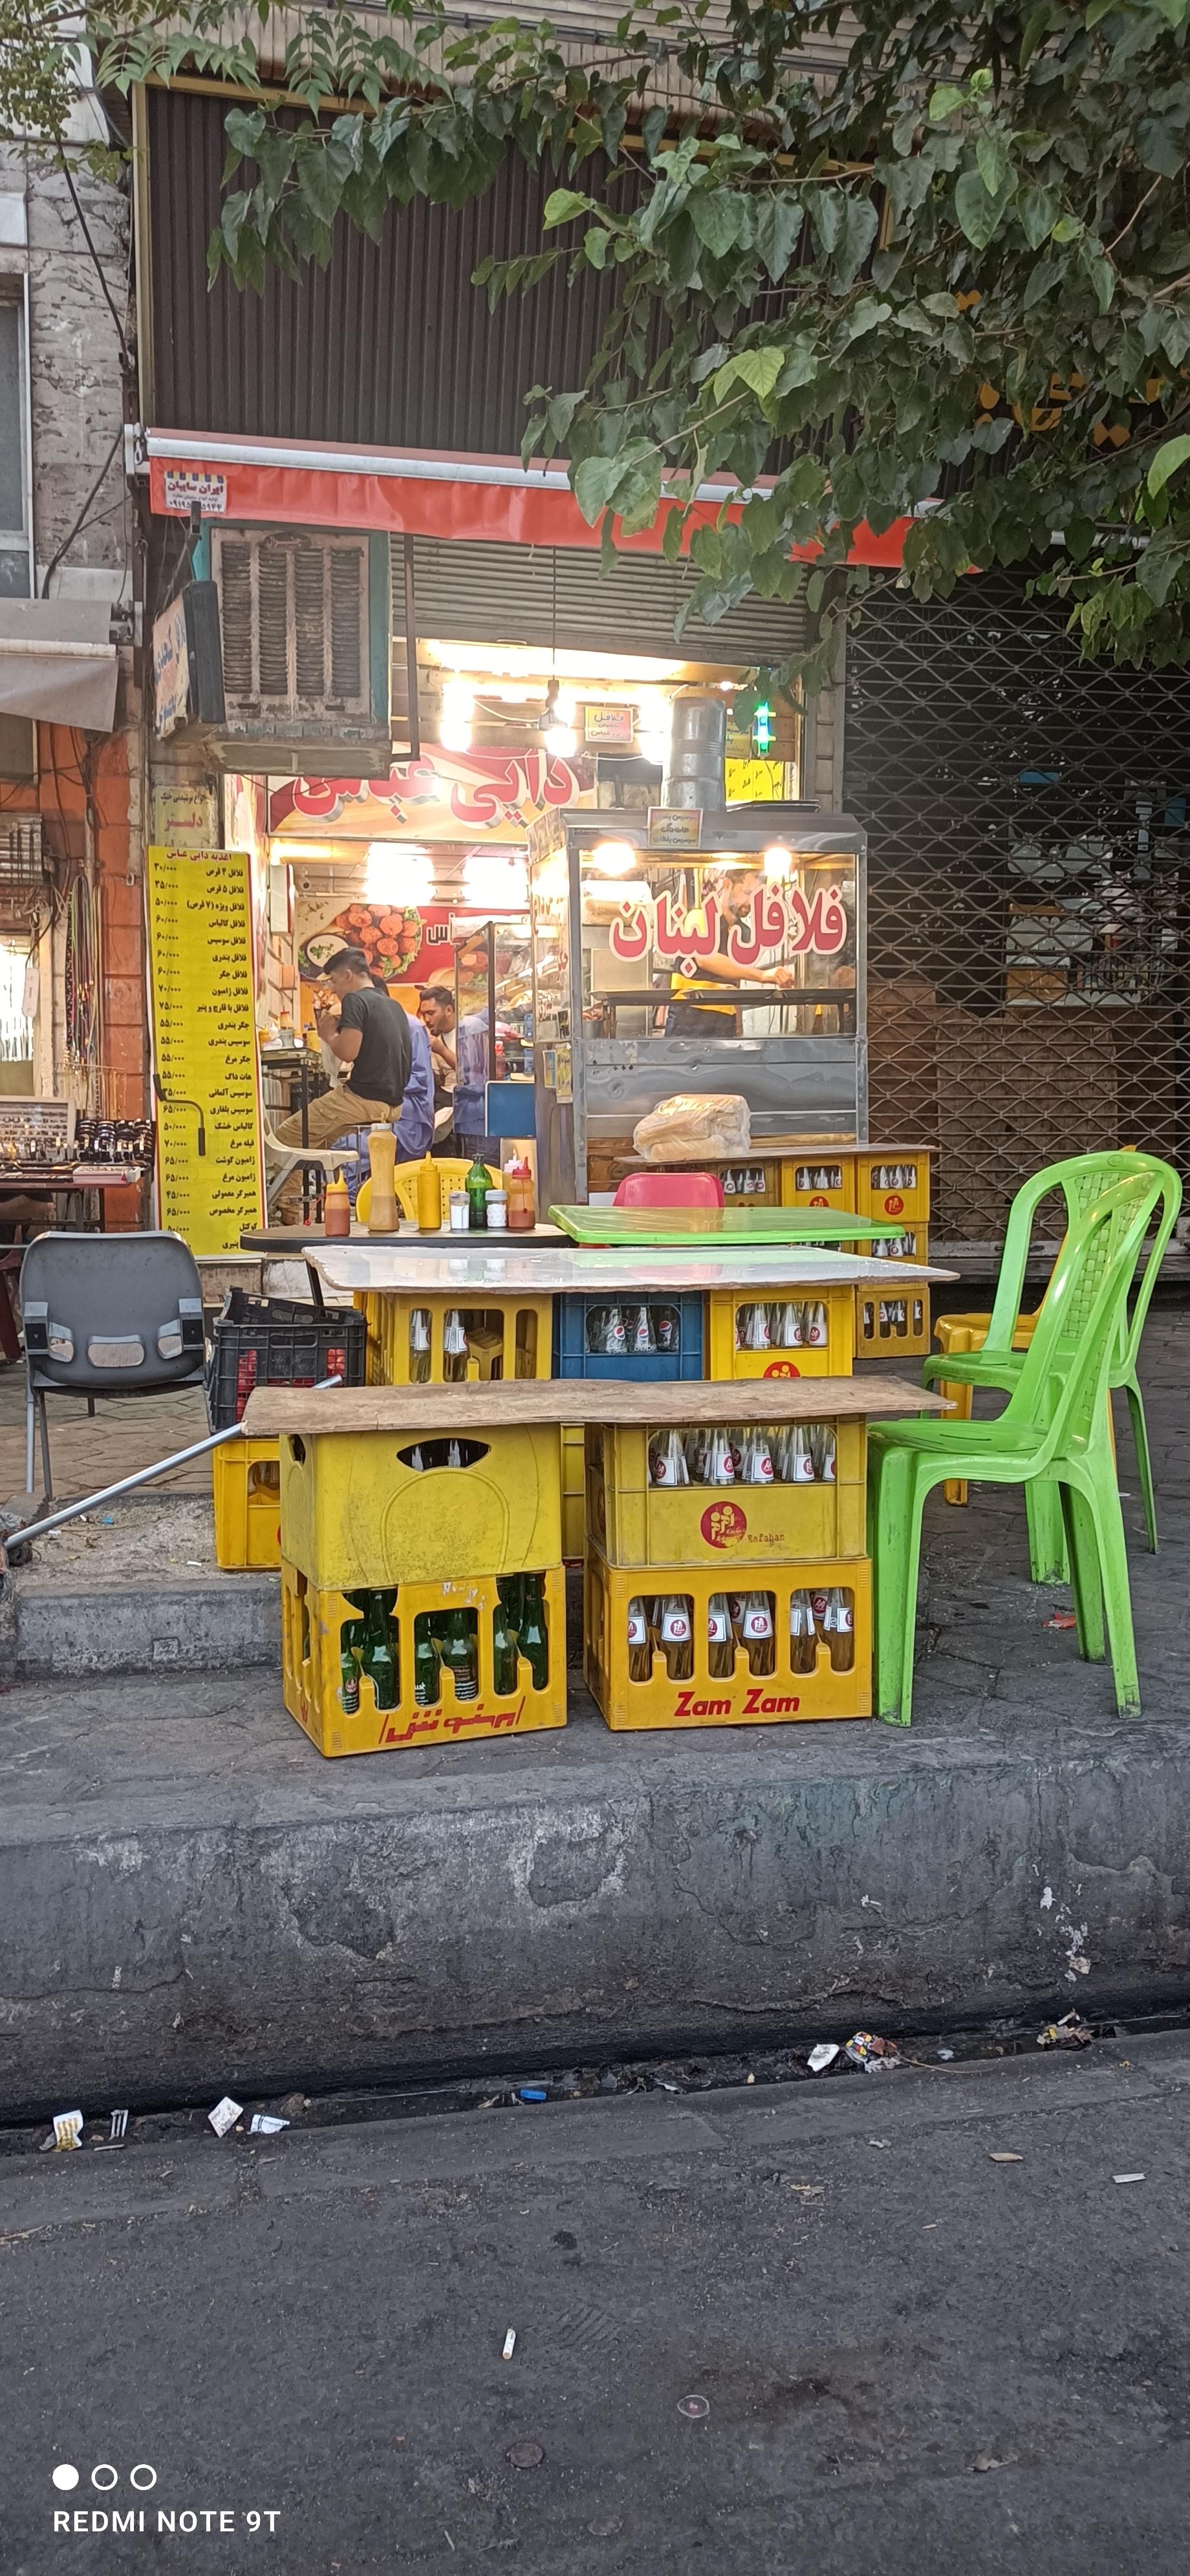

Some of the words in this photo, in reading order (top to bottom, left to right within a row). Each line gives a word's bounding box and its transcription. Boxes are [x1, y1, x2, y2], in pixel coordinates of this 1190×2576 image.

[168, 481, 197, 492] سایبان
[199, 484, 223, 495] ایران
[169, 500, 222, 510] ۰۹۱۹۵۵۹۴۴
[594, 711, 624, 722] فلافل
[451, 749, 574, 824] دایی
[164, 812, 203, 832] دلستر
[166, 849, 188, 859] عباس
[189, 851, 208, 861] دایی
[211, 853, 232, 863] اغذیه
[154, 863, 177, 872] ۳۰/۰۰۰
[206, 867, 221, 877] قرص
[228, 869, 243, 878] فلافل
[155, 880, 178, 889] ۳۵/۰۰۰
[222, 885, 228, 893] ۵
[207, 885, 221, 894] قرص
[228, 885, 244, 895] فلافل
[155, 897, 178, 906] ۵۰/۰۰۰
[215, 903, 228, 912] ویژه
[230, 903, 244, 912] فلافل
[156, 914, 178, 923] ۶۰/۰۰۰
[208, 919, 228, 928] کالباس
[230, 919, 245, 928] فلافل
[728, 883, 846, 967] فلافل
[157, 932, 178, 941] ۶۰/۰۰۰
[610, 891, 721, 976] لبنان
[231, 936, 246, 946] فلافل
[157, 949, 179, 958] ۶۰/۰۰۰
[212, 954, 230, 962] بندری
[232, 954, 247, 963] فلافل
[158, 967, 180, 975] ۶۰/۰۰۰
[232, 970, 247, 980] فلافل
[212, 987, 232, 996] ژامبون
[233, 987, 248, 996] فلافل
[159, 1002, 182, 1010] ۷۵/۰۰۰
[197, 1004, 207, 1013] پنیر
[213, 1004, 226, 1013] قارچ
[228, 1004, 232, 1013] با
[233, 1004, 249, 1013] فلافل
[218, 1022, 236, 1030] بندری
[208, 1038, 226, 1046] بندری
[162, 1053, 184, 1062] ۵۵/۰۰۰
[225, 1055, 237, 1064] مرغ
[208, 1088, 228, 1098] آلمانی
[163, 1105, 186, 1113] ۶۵/۰۰۰
[164, 1122, 186, 1131] ۵۰/۰۰۰
[233, 1122, 253, 1132] کالباس
[164, 1139, 187, 1148] ۷۰/۰۰۰
[230, 1139, 242, 1148] مرغ
[244, 1139, 254, 1148] فیله
[165, 1156, 188, 1165] ۶۵/۰۰۰
[235, 1156, 255, 1165] ژامبون
[166, 1174, 189, 1182] ۶۵/۰۰۰
[222, 1172, 234, 1183] مرغ
[235, 1173, 255, 1182] ژامبون
[166, 1190, 189, 1199] ۴۵/۰۰۰
[212, 1190, 234, 1199] معمولی
[209, 1207, 235, 1216] مخصوص
[239, 1223, 257, 1232] کوکتل
[748, 1533, 785, 1543] Esfahan
[674, 1691, 731, 1716] Zam
[742, 1688, 800, 1714] Zam
